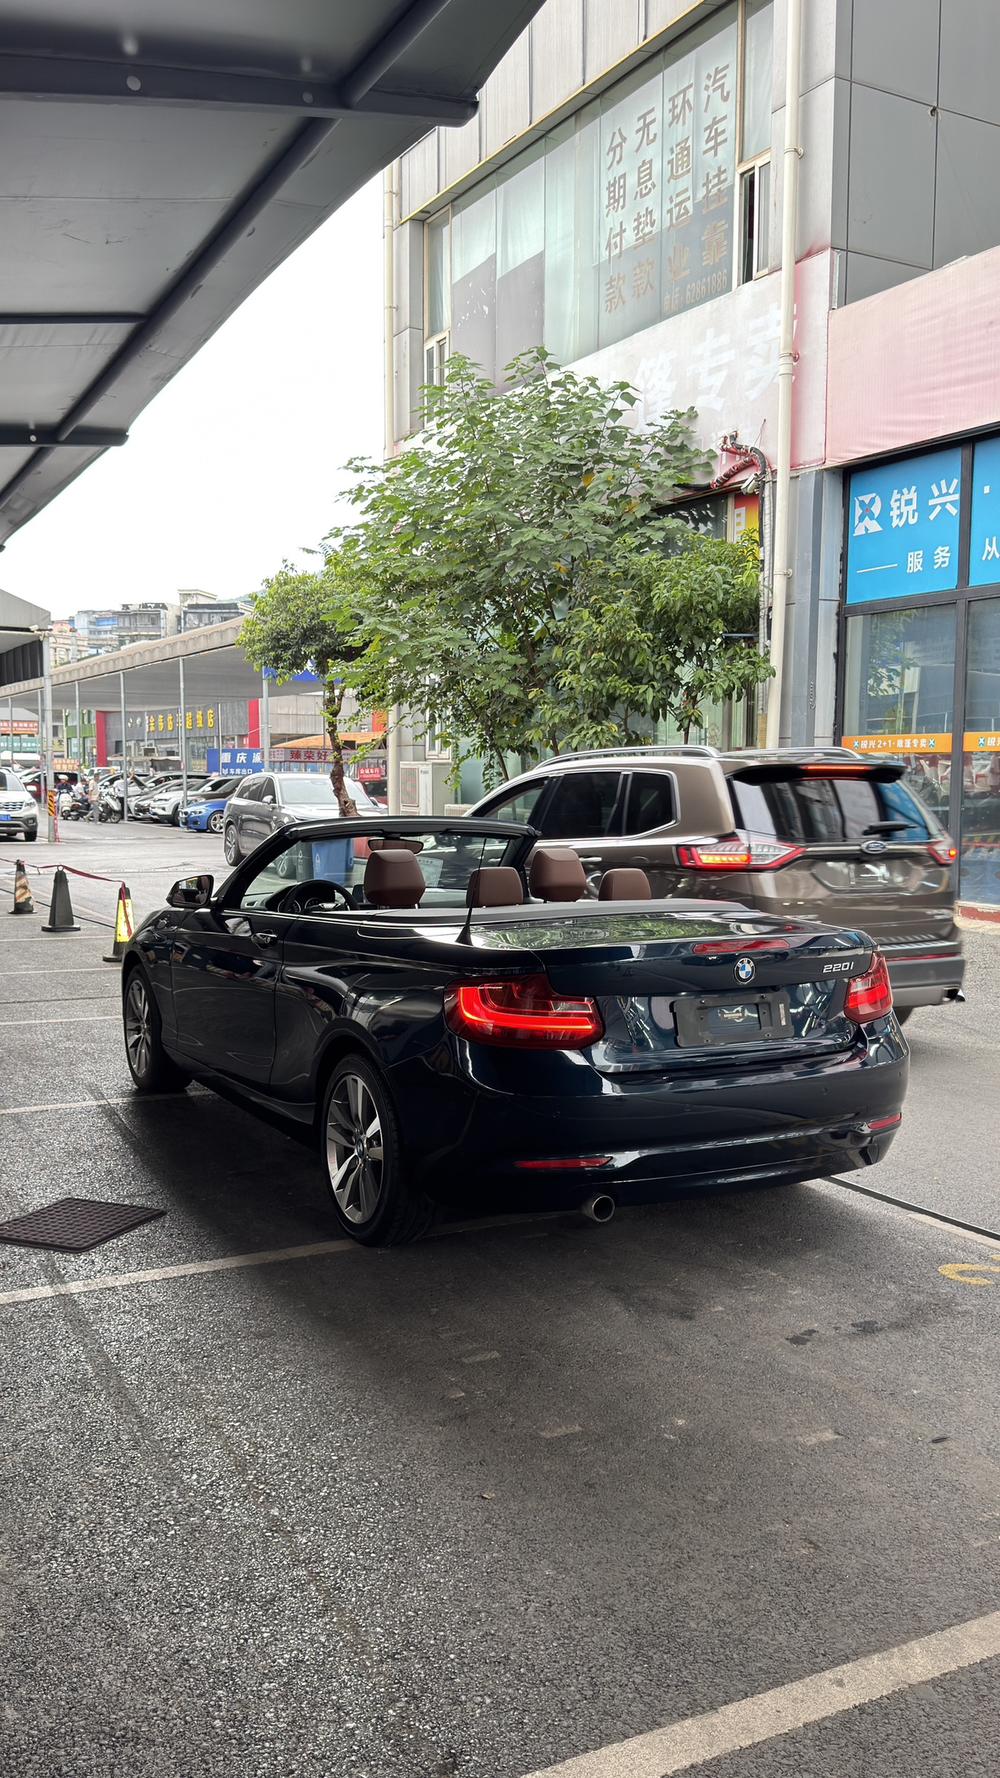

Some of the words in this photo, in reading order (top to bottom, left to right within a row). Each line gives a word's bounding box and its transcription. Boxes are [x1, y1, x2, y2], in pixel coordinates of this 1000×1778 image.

[605, 127, 627, 314] 分期付款
[632, 106, 658, 298] 无息垫款
[666, 83, 694, 284] 环通运业
[702, 64, 730, 268] 汽车挂靠
[889, 478, 961, 528] 锐兴
[906, 545, 951, 573] 服务
